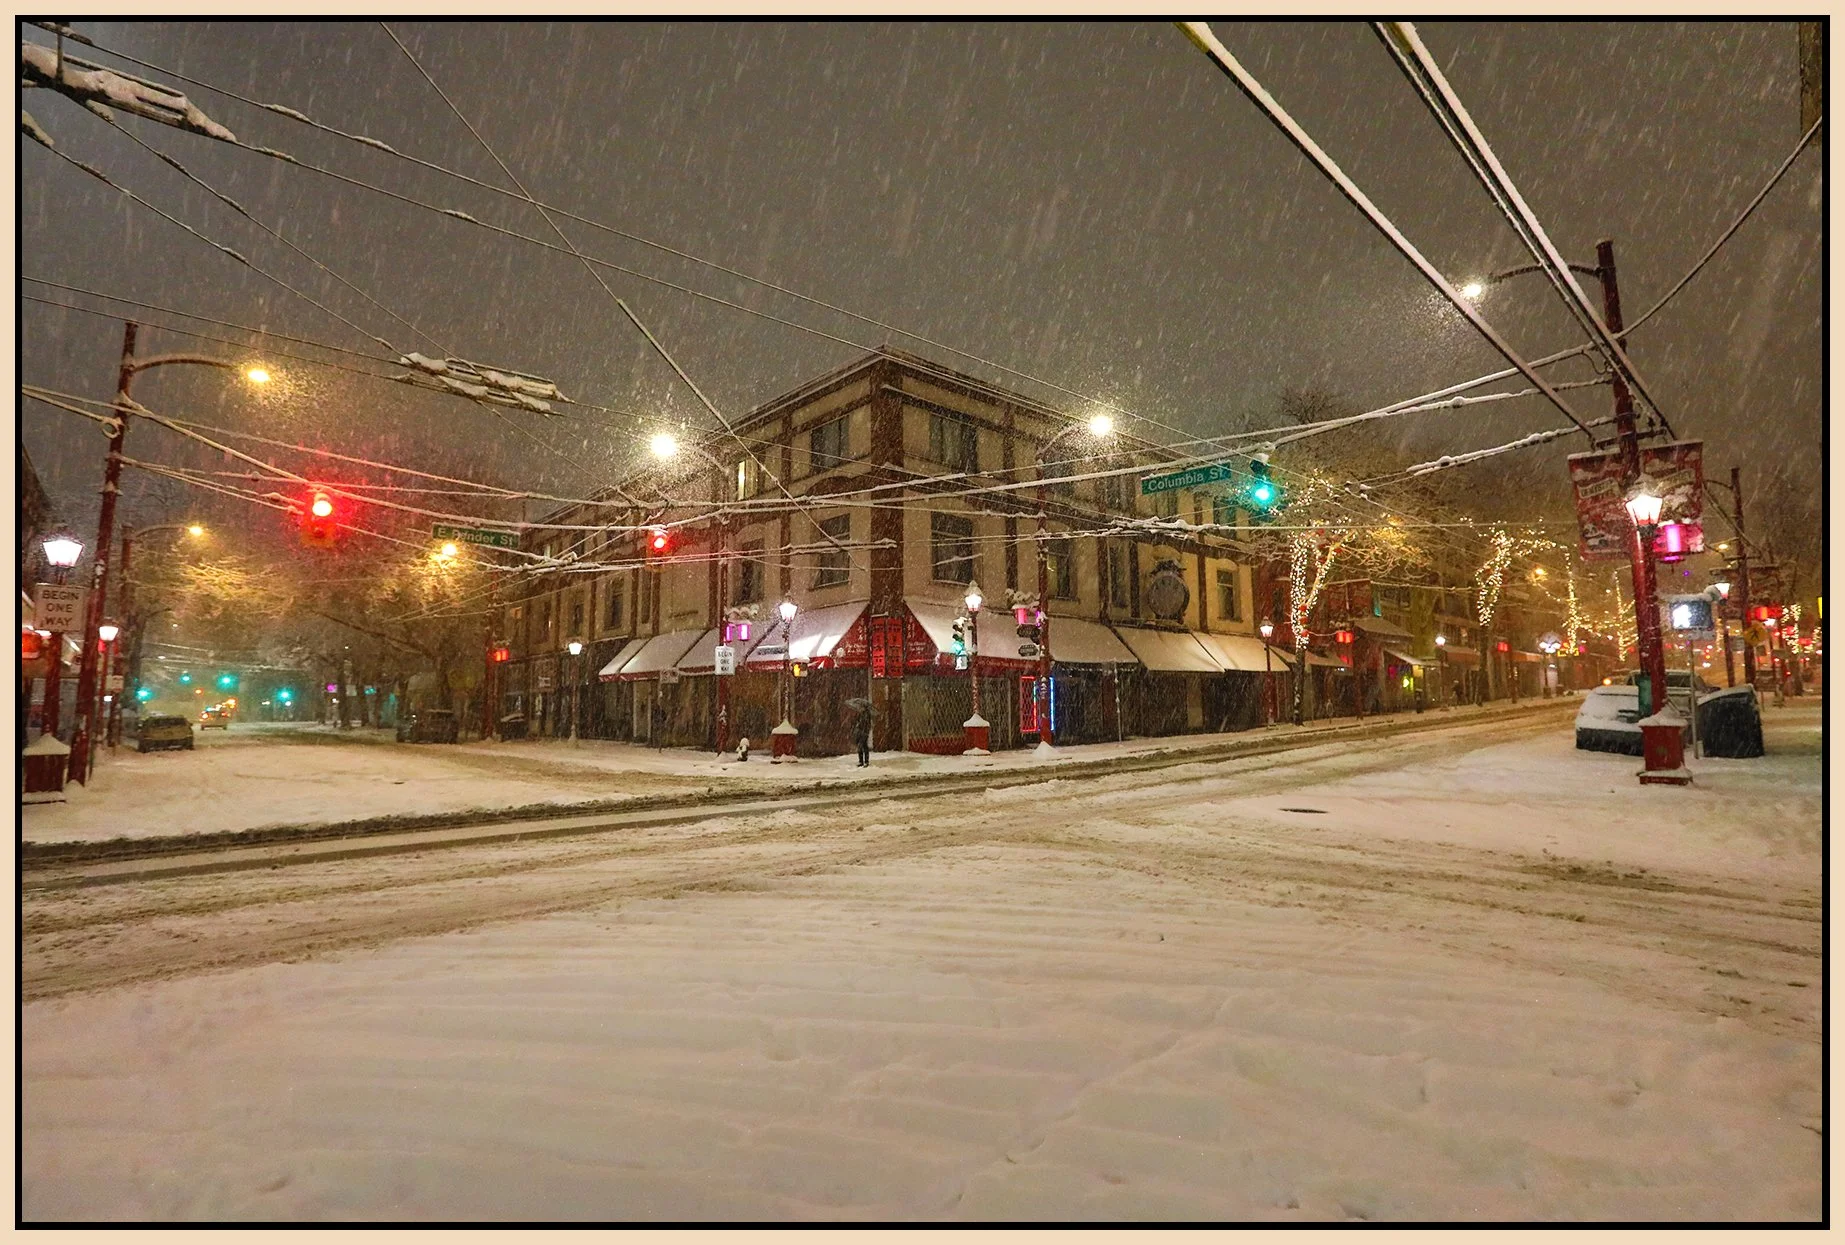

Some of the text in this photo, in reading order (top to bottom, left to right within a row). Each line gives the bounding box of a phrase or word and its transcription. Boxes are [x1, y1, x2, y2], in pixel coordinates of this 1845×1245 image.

[1147, 471, 1205, 491] Columbia
[437, 527, 446, 537] E
[500, 535, 514, 545] St
[42, 589, 80, 600] BEGIN
[46, 602, 73, 613] ONE
[44, 616, 73, 626] WAY
